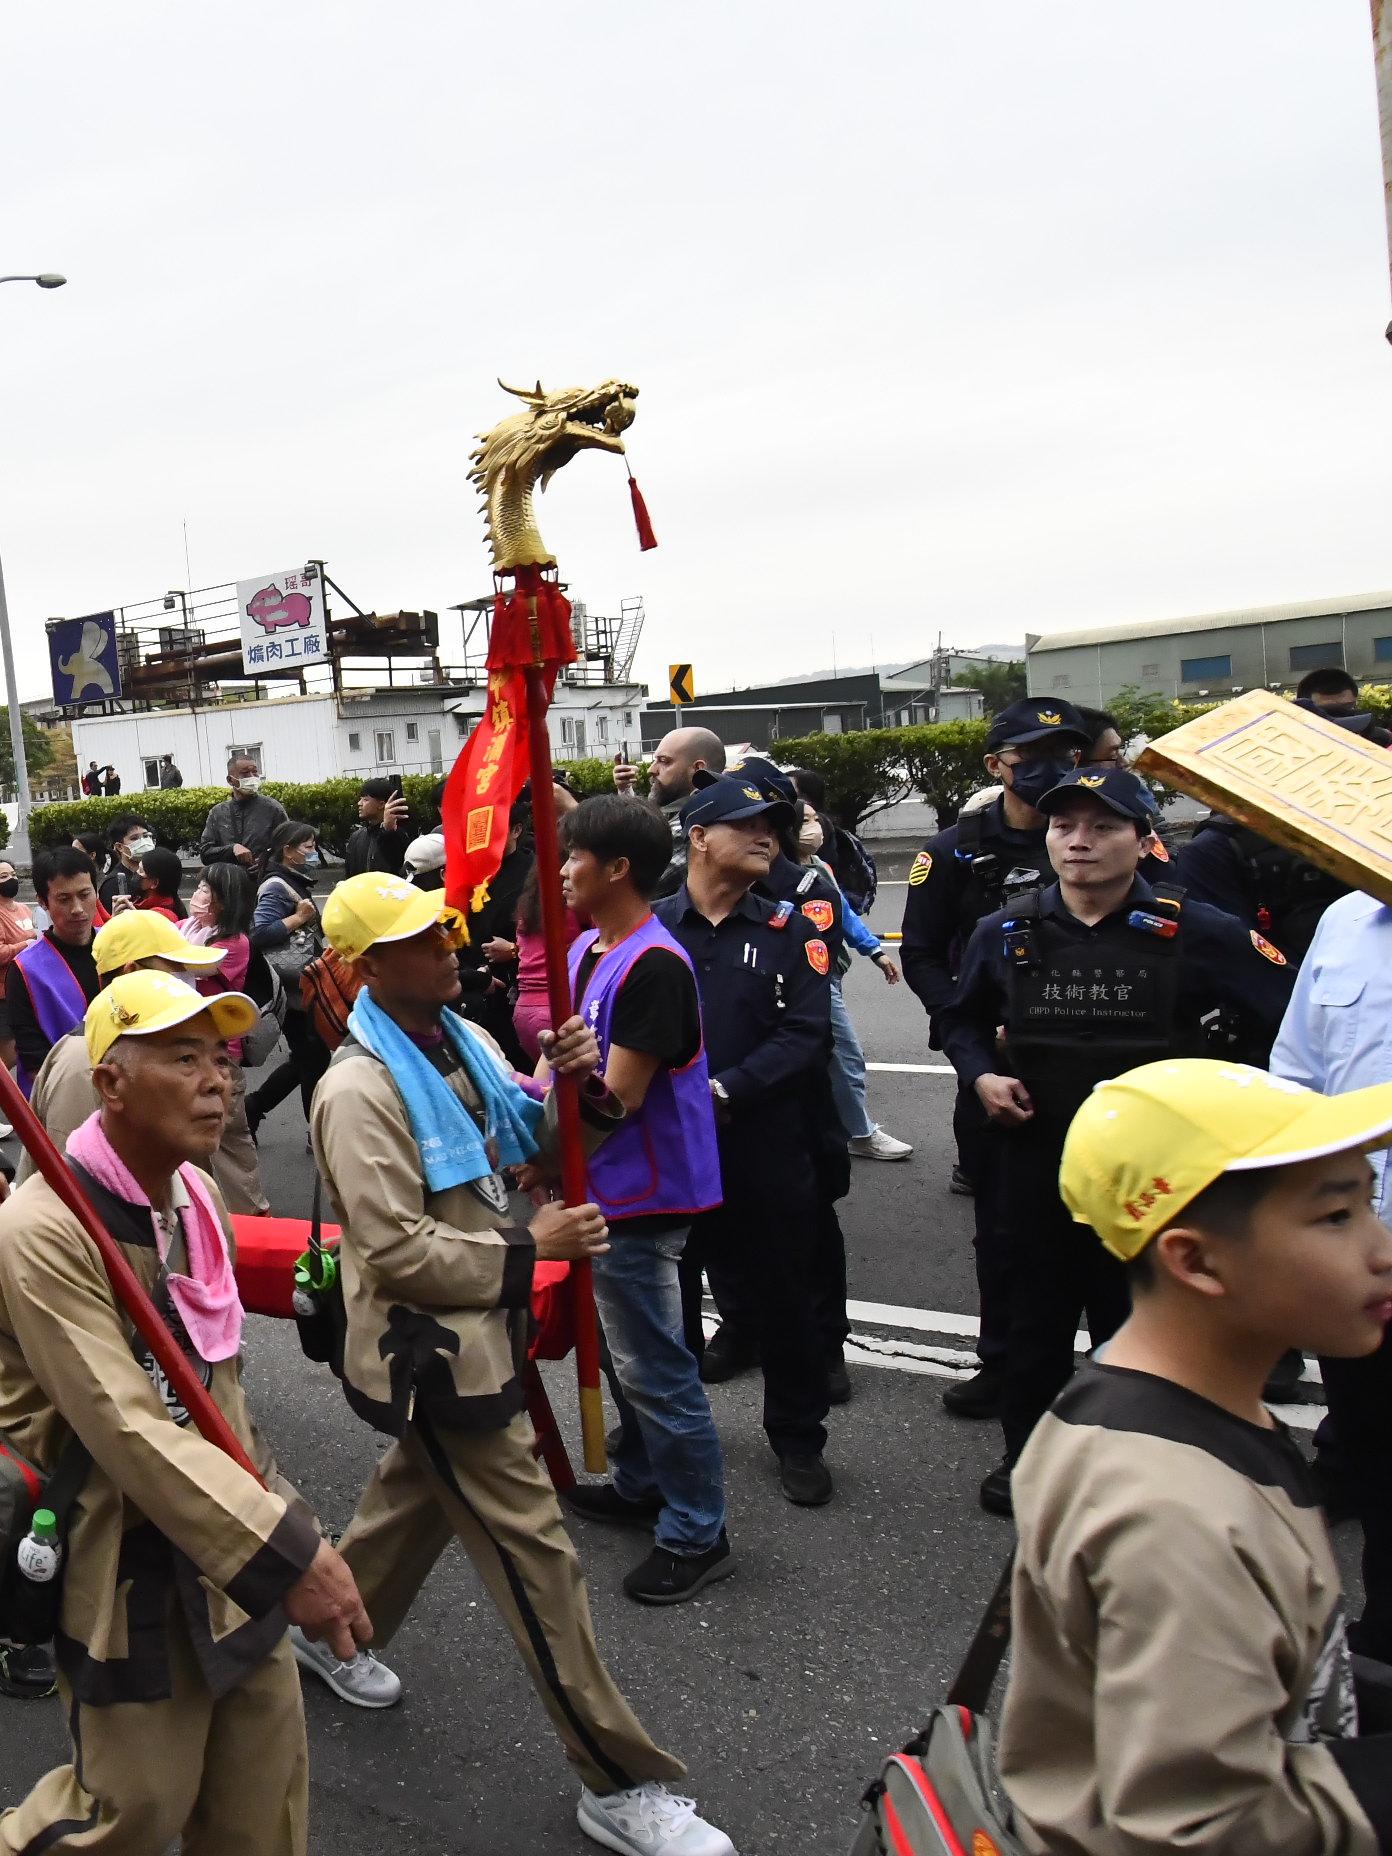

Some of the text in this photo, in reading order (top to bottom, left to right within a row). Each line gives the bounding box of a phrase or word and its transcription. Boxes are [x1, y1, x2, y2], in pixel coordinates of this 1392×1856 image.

[476, 672, 513, 795] 甲鎮瀾宮
[1041, 983, 1134, 1001] 技術教官
[1054, 1006, 1087, 1016] Police
[1093, 1007, 1148, 1018] Instructor
